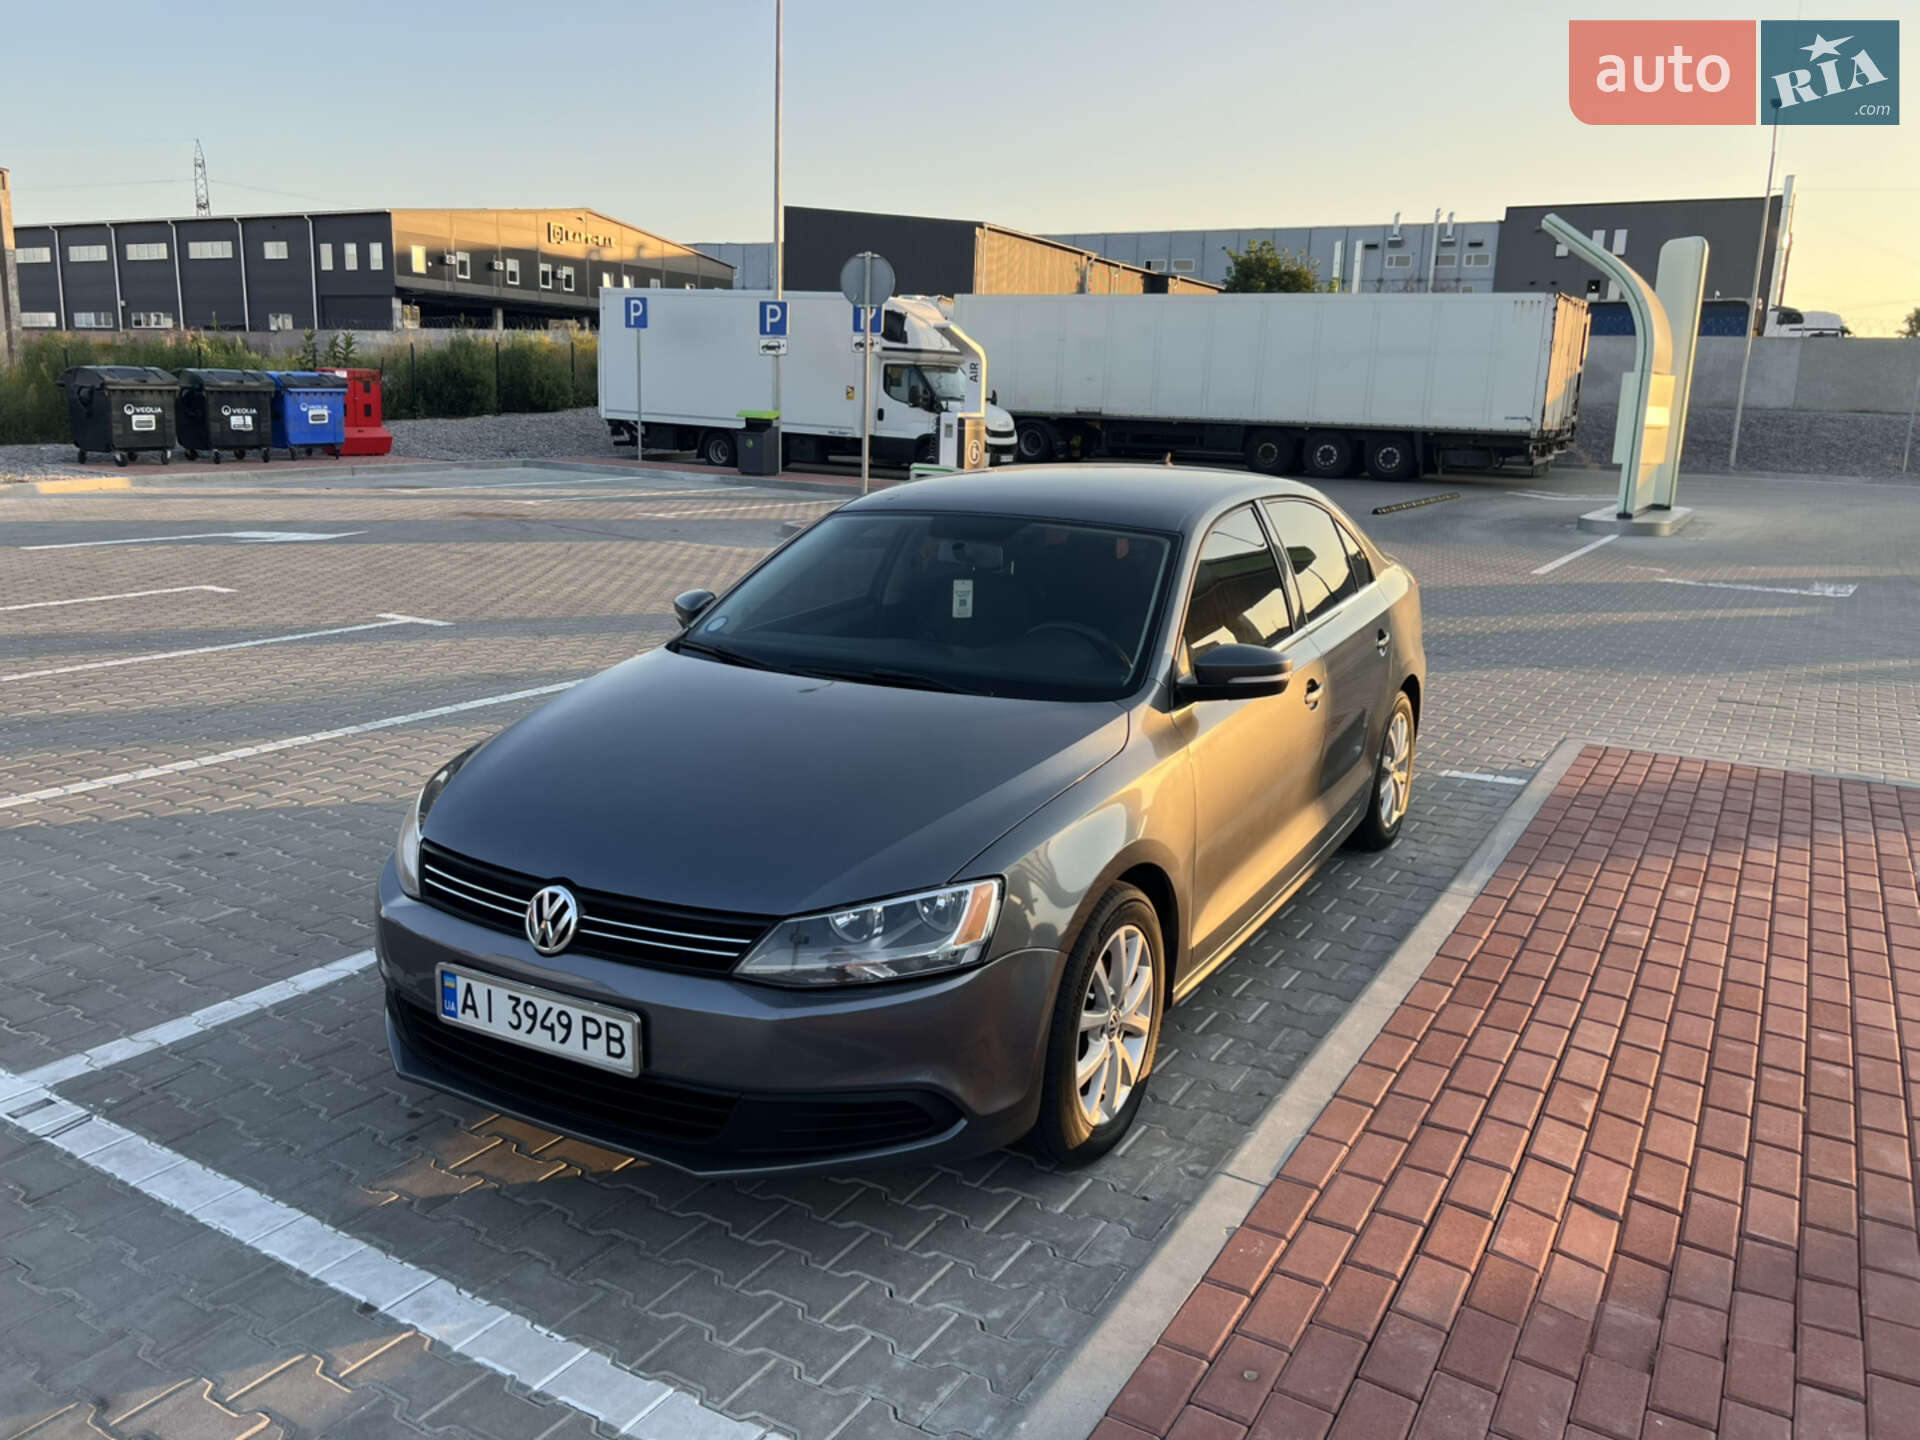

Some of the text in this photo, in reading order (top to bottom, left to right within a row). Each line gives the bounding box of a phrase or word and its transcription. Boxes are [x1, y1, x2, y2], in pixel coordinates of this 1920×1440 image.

[629, 299, 643, 326] P
[766, 304, 782, 333] P
[969, 362, 979, 383] AIR
[444, 1000, 456, 1012] UA
[461, 982, 626, 1060] AI 3949 PB
